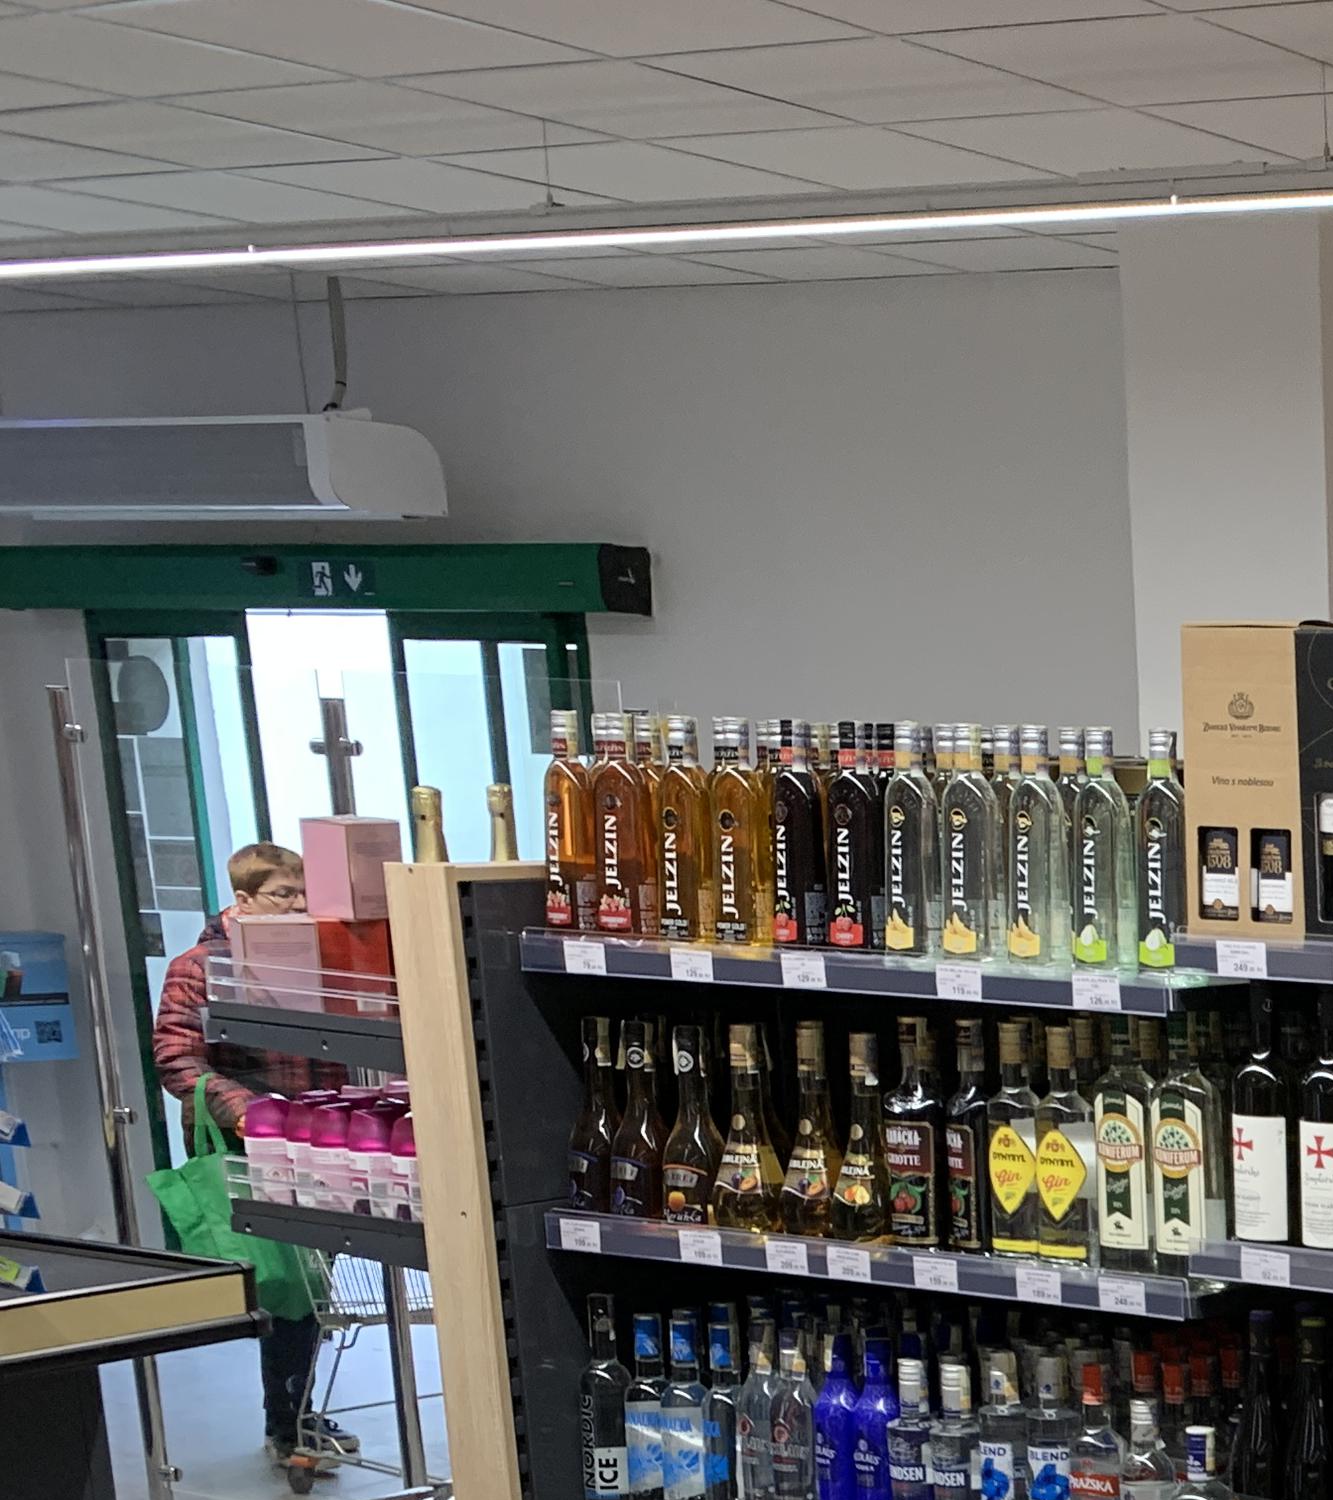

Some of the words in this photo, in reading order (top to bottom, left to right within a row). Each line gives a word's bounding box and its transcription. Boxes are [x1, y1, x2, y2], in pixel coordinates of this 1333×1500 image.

[603, 814, 621, 890] JELZIN
[664, 831, 682, 916] JELZIN
[721, 835, 739, 919] JELZIN
[837, 827, 853, 905] JELZIN
[891, 830, 905, 908] JELZIN
[951, 831, 967, 911] JELZIN
[1016, 834, 1032, 914] JELZIN
[1083, 838, 1097, 919] JELZIN
[1148, 841, 1166, 924] JELZIN
[995, 1170, 1021, 1186] Gin
[1041, 1174, 1070, 1191] Gin
[599, 1456, 619, 1491] ICE
[1029, 1449, 1070, 1461] BLEND
